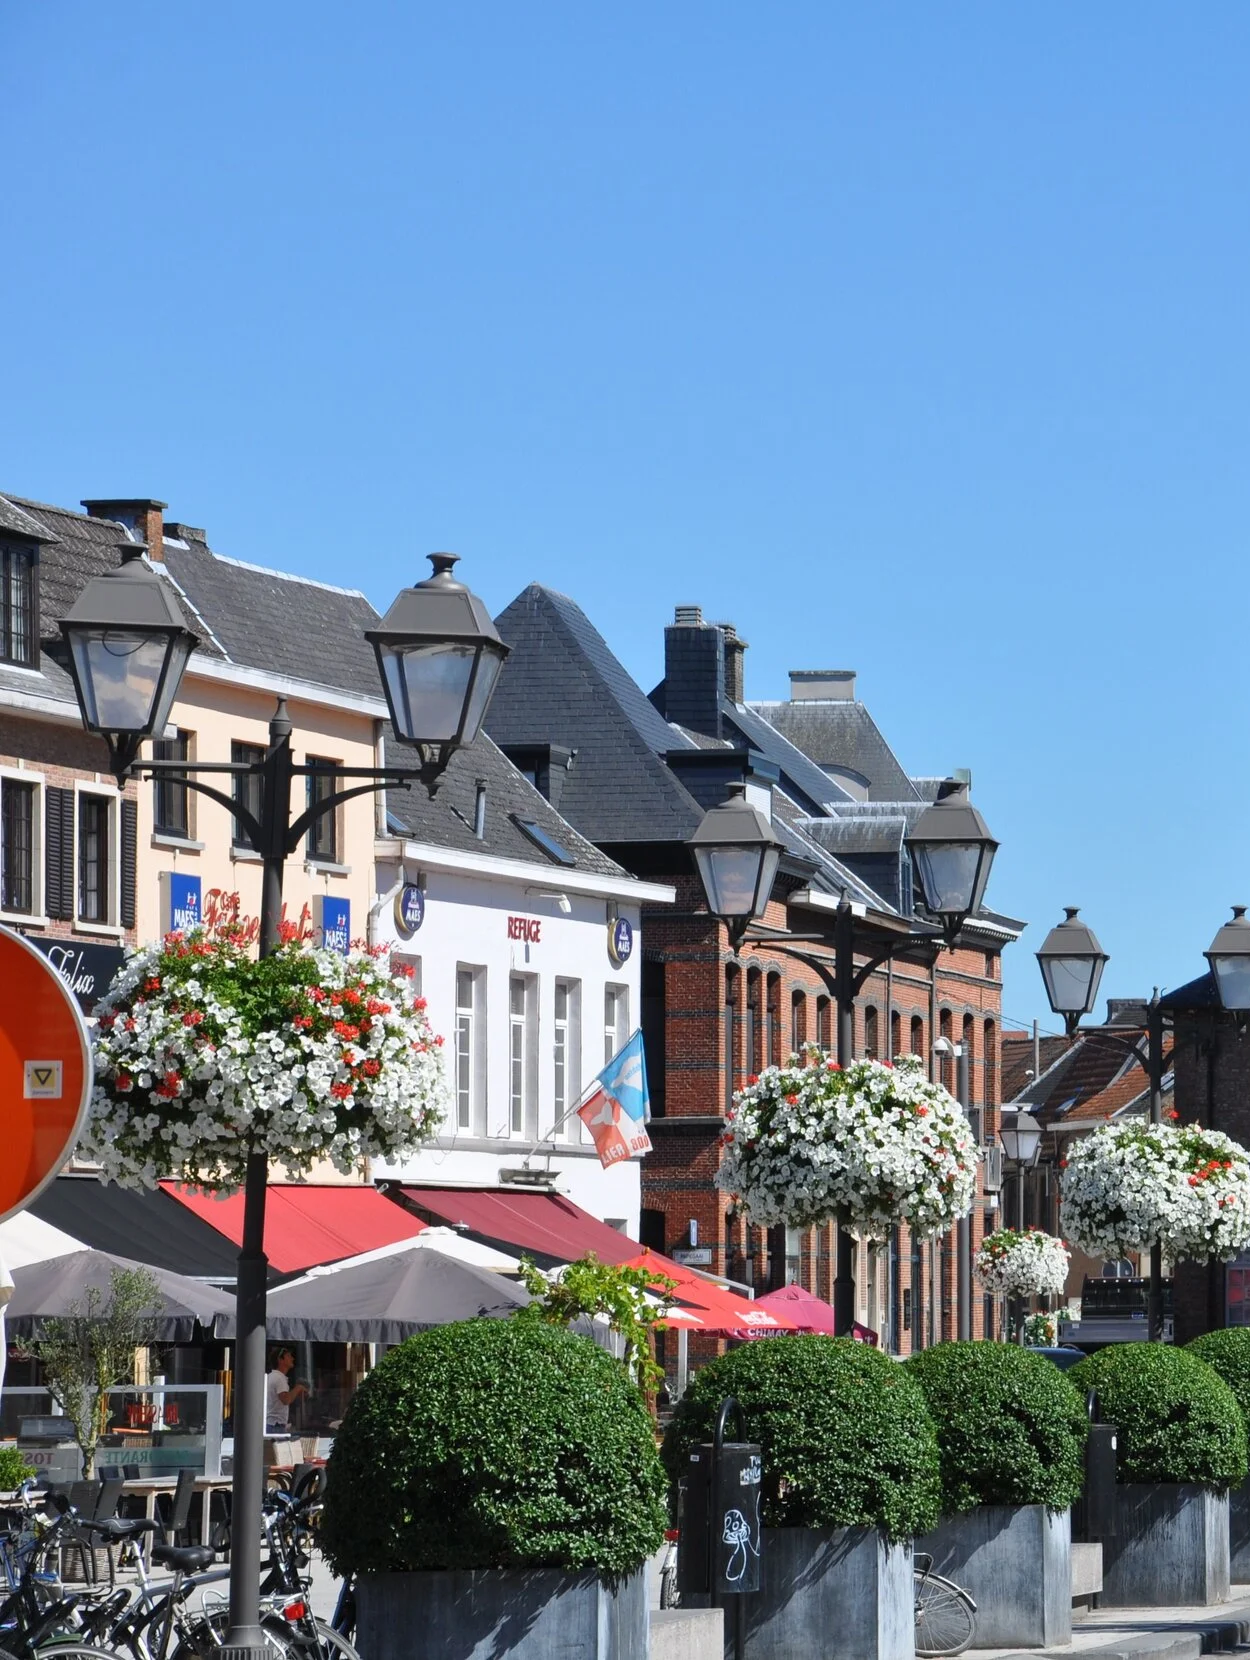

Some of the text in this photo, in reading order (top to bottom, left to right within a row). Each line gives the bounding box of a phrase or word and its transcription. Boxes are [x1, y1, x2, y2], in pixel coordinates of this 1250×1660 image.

[174, 908, 194, 929] MAES
[405, 908, 422, 922] MAES
[325, 929, 344, 949] MAES
[507, 916, 541, 943] REFUGE
[617, 940, 630, 953] MAES
[601, 1135, 650, 1164] LIER 800
[747, 1328, 789, 1338] CHIMAY
